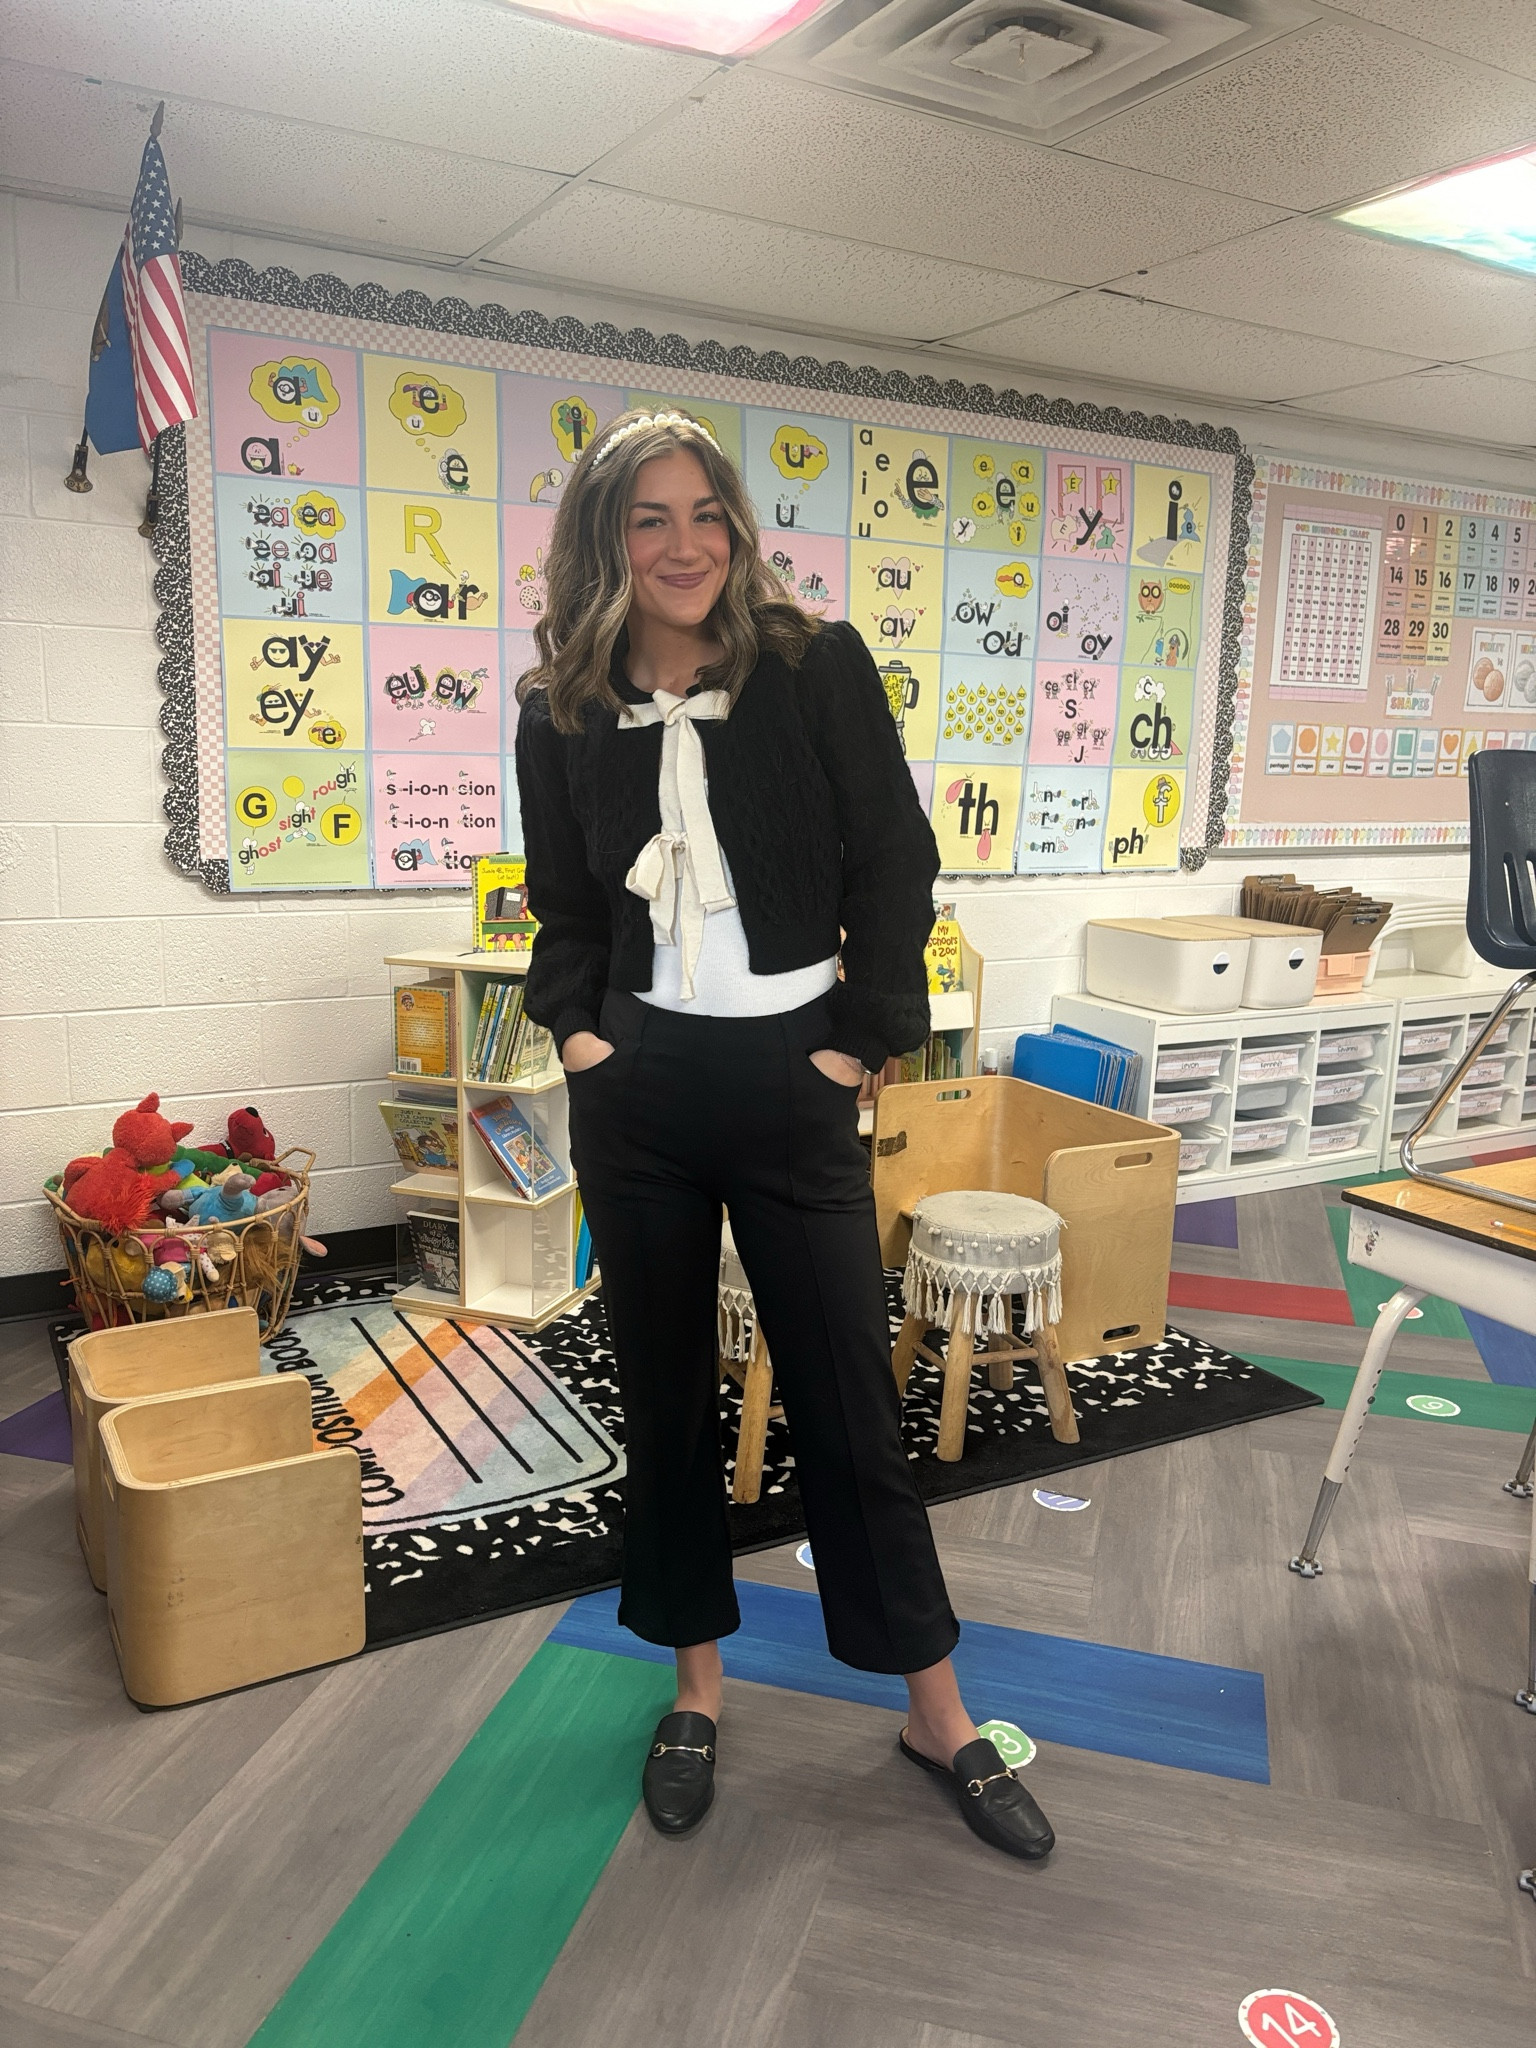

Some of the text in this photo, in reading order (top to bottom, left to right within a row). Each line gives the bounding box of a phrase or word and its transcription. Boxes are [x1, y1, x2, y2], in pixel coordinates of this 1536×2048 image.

[273, 376, 302, 405] a
[419, 387, 440, 414] e
[308, 411, 319, 422] u
[411, 420, 420, 429] u
[571, 406, 583, 450] i
[859, 429, 873, 446] a
[240, 436, 281, 476] a
[785, 442, 805, 468] u
[876, 453, 891, 472] e
[444, 454, 469, 487] e
[980, 461, 988, 472] e
[1018, 466, 1030, 479] a
[862, 470, 867, 495] i
[906, 458, 939, 510] e
[1070, 477, 1077, 489] E
[996, 478, 1016, 508] e
[874, 499, 889, 518] o
[977, 500, 987, 511] o
[1026, 502, 1035, 513] u
[1166, 479, 1183, 542] i
[776, 503, 795, 528] u
[1396, 513, 1405, 531] 0
[858, 522, 871, 538] u
[957, 520, 970, 537] y
[1016, 526, 1021, 541] i
[1076, 507, 1103, 546] y
[1186, 522, 1193, 534] e
[1422, 517, 1428, 534] 1
[1445, 520, 1453, 536] 2
[1468, 522, 1476, 539] 3
[1491, 524, 1499, 541] 4
[1514, 527, 1521, 543] 5
[403, 504, 457, 580] R
[772, 550, 794, 571] er
[878, 568, 911, 590] au
[1390, 566, 1403, 584] 14
[1415, 568, 1428, 587] 15
[1439, 570, 1452, 588] 16
[1464, 573, 1476, 590] 17
[1486, 575, 1498, 592] 18
[1508, 577, 1520, 594] 19
[412, 582, 480, 621] ar
[956, 602, 995, 627] ow
[880, 617, 916, 638] aw
[1384, 618, 1400, 636] 28
[1408, 620, 1424, 638] 29
[1432, 622, 1449, 639] 30
[983, 630, 1023, 657] ou
[261, 635, 331, 682] ay
[259, 688, 316, 737] ey
[1064, 698, 1077, 719] S
[1390, 696, 1430, 711] SHAPES
[1130, 702, 1172, 750] ch
[323, 728, 337, 745] e
[313, 768, 357, 801] rough
[243, 792, 268, 820] G
[958, 782, 999, 836] th
[279, 807, 317, 831] sight
[334, 813, 351, 839] F
[238, 836, 282, 865] ghost
[1112, 827, 1144, 864] ph
[938, 925, 949, 936] My
[938, 946, 958, 958] Zoo!
[423, 1220, 448, 1231] DIARY
[988, 1729, 1023, 1755] 3
[1260, 2002, 1323, 2048] 14
